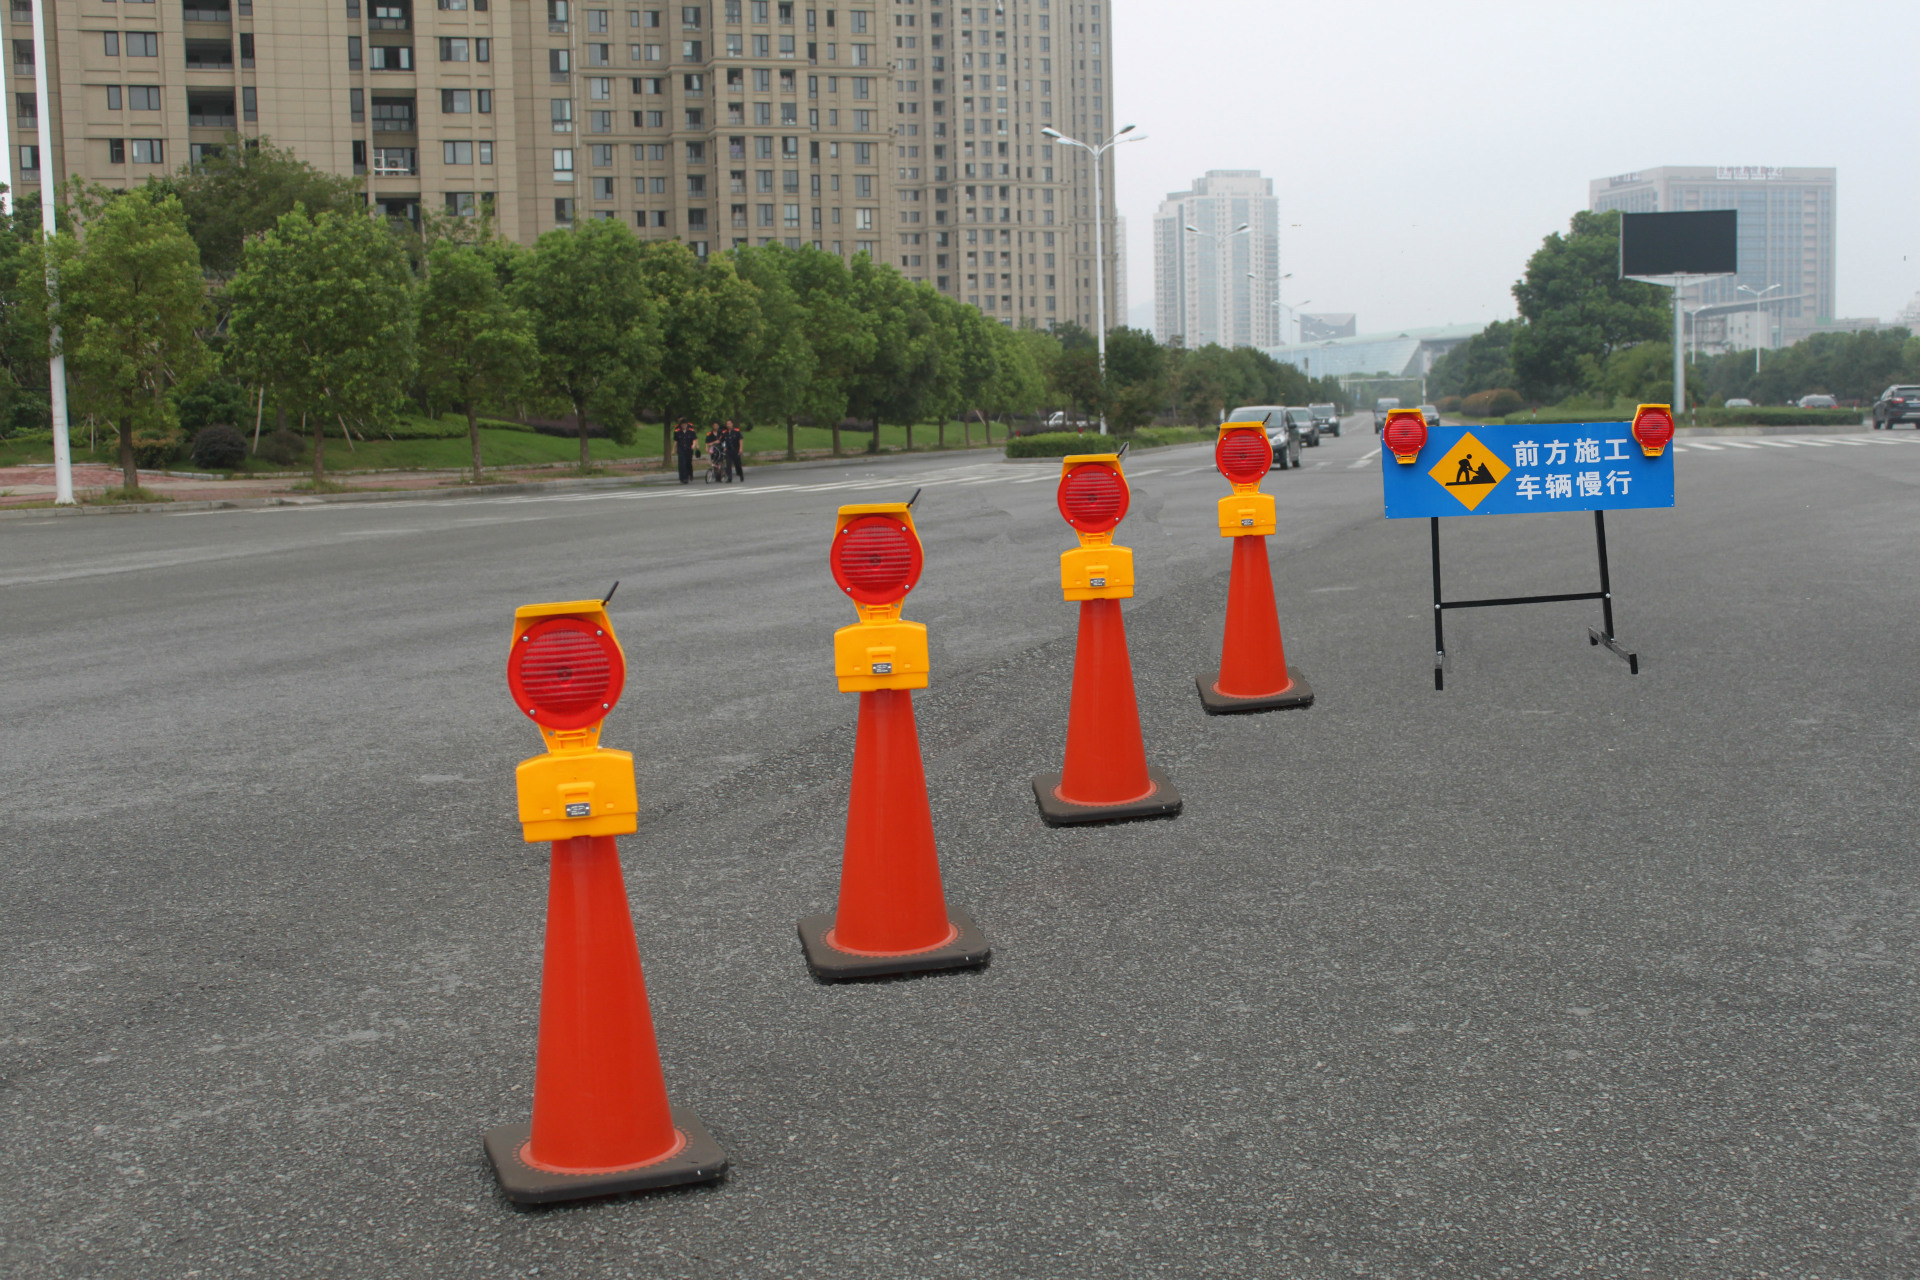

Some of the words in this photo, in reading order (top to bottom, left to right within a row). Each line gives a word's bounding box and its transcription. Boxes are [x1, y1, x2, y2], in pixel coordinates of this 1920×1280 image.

[1512, 438, 1631, 467] 前方施工
[1515, 470, 1633, 500] 车辆慢行
